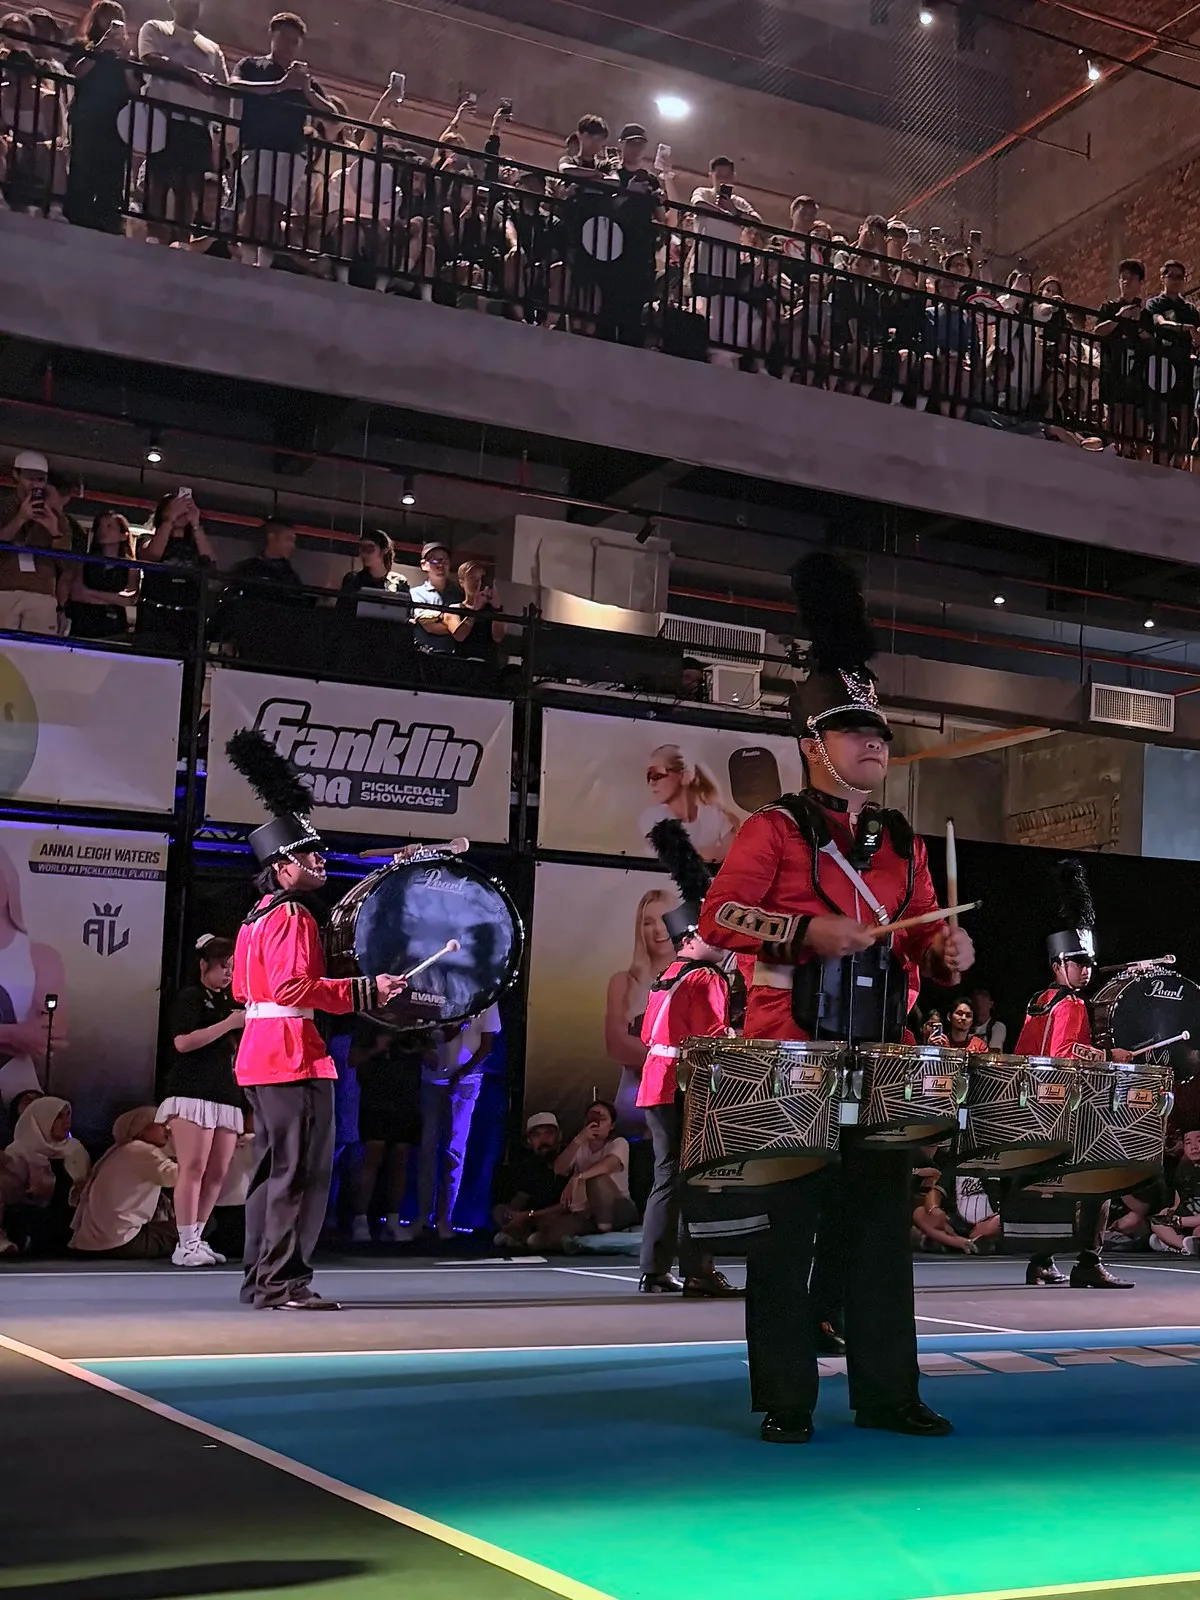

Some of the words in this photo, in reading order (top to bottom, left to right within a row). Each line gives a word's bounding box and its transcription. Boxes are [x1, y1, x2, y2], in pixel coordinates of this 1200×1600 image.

[361, 781, 450, 798] PICKLEBALL
[360, 791, 444, 807] SHOWCASE
[39, 843, 74, 858] ANNA
[77, 845, 112, 861] LEIGH
[115, 848, 161, 864] WATERS
[38, 863, 67, 873] WORLD
[79, 866, 128, 877] PICKLEBALL
[129, 869, 160, 880] PLAYER
[411, 991, 446, 1004] EVANS
[1144, 979, 1184, 1001] Pearl
